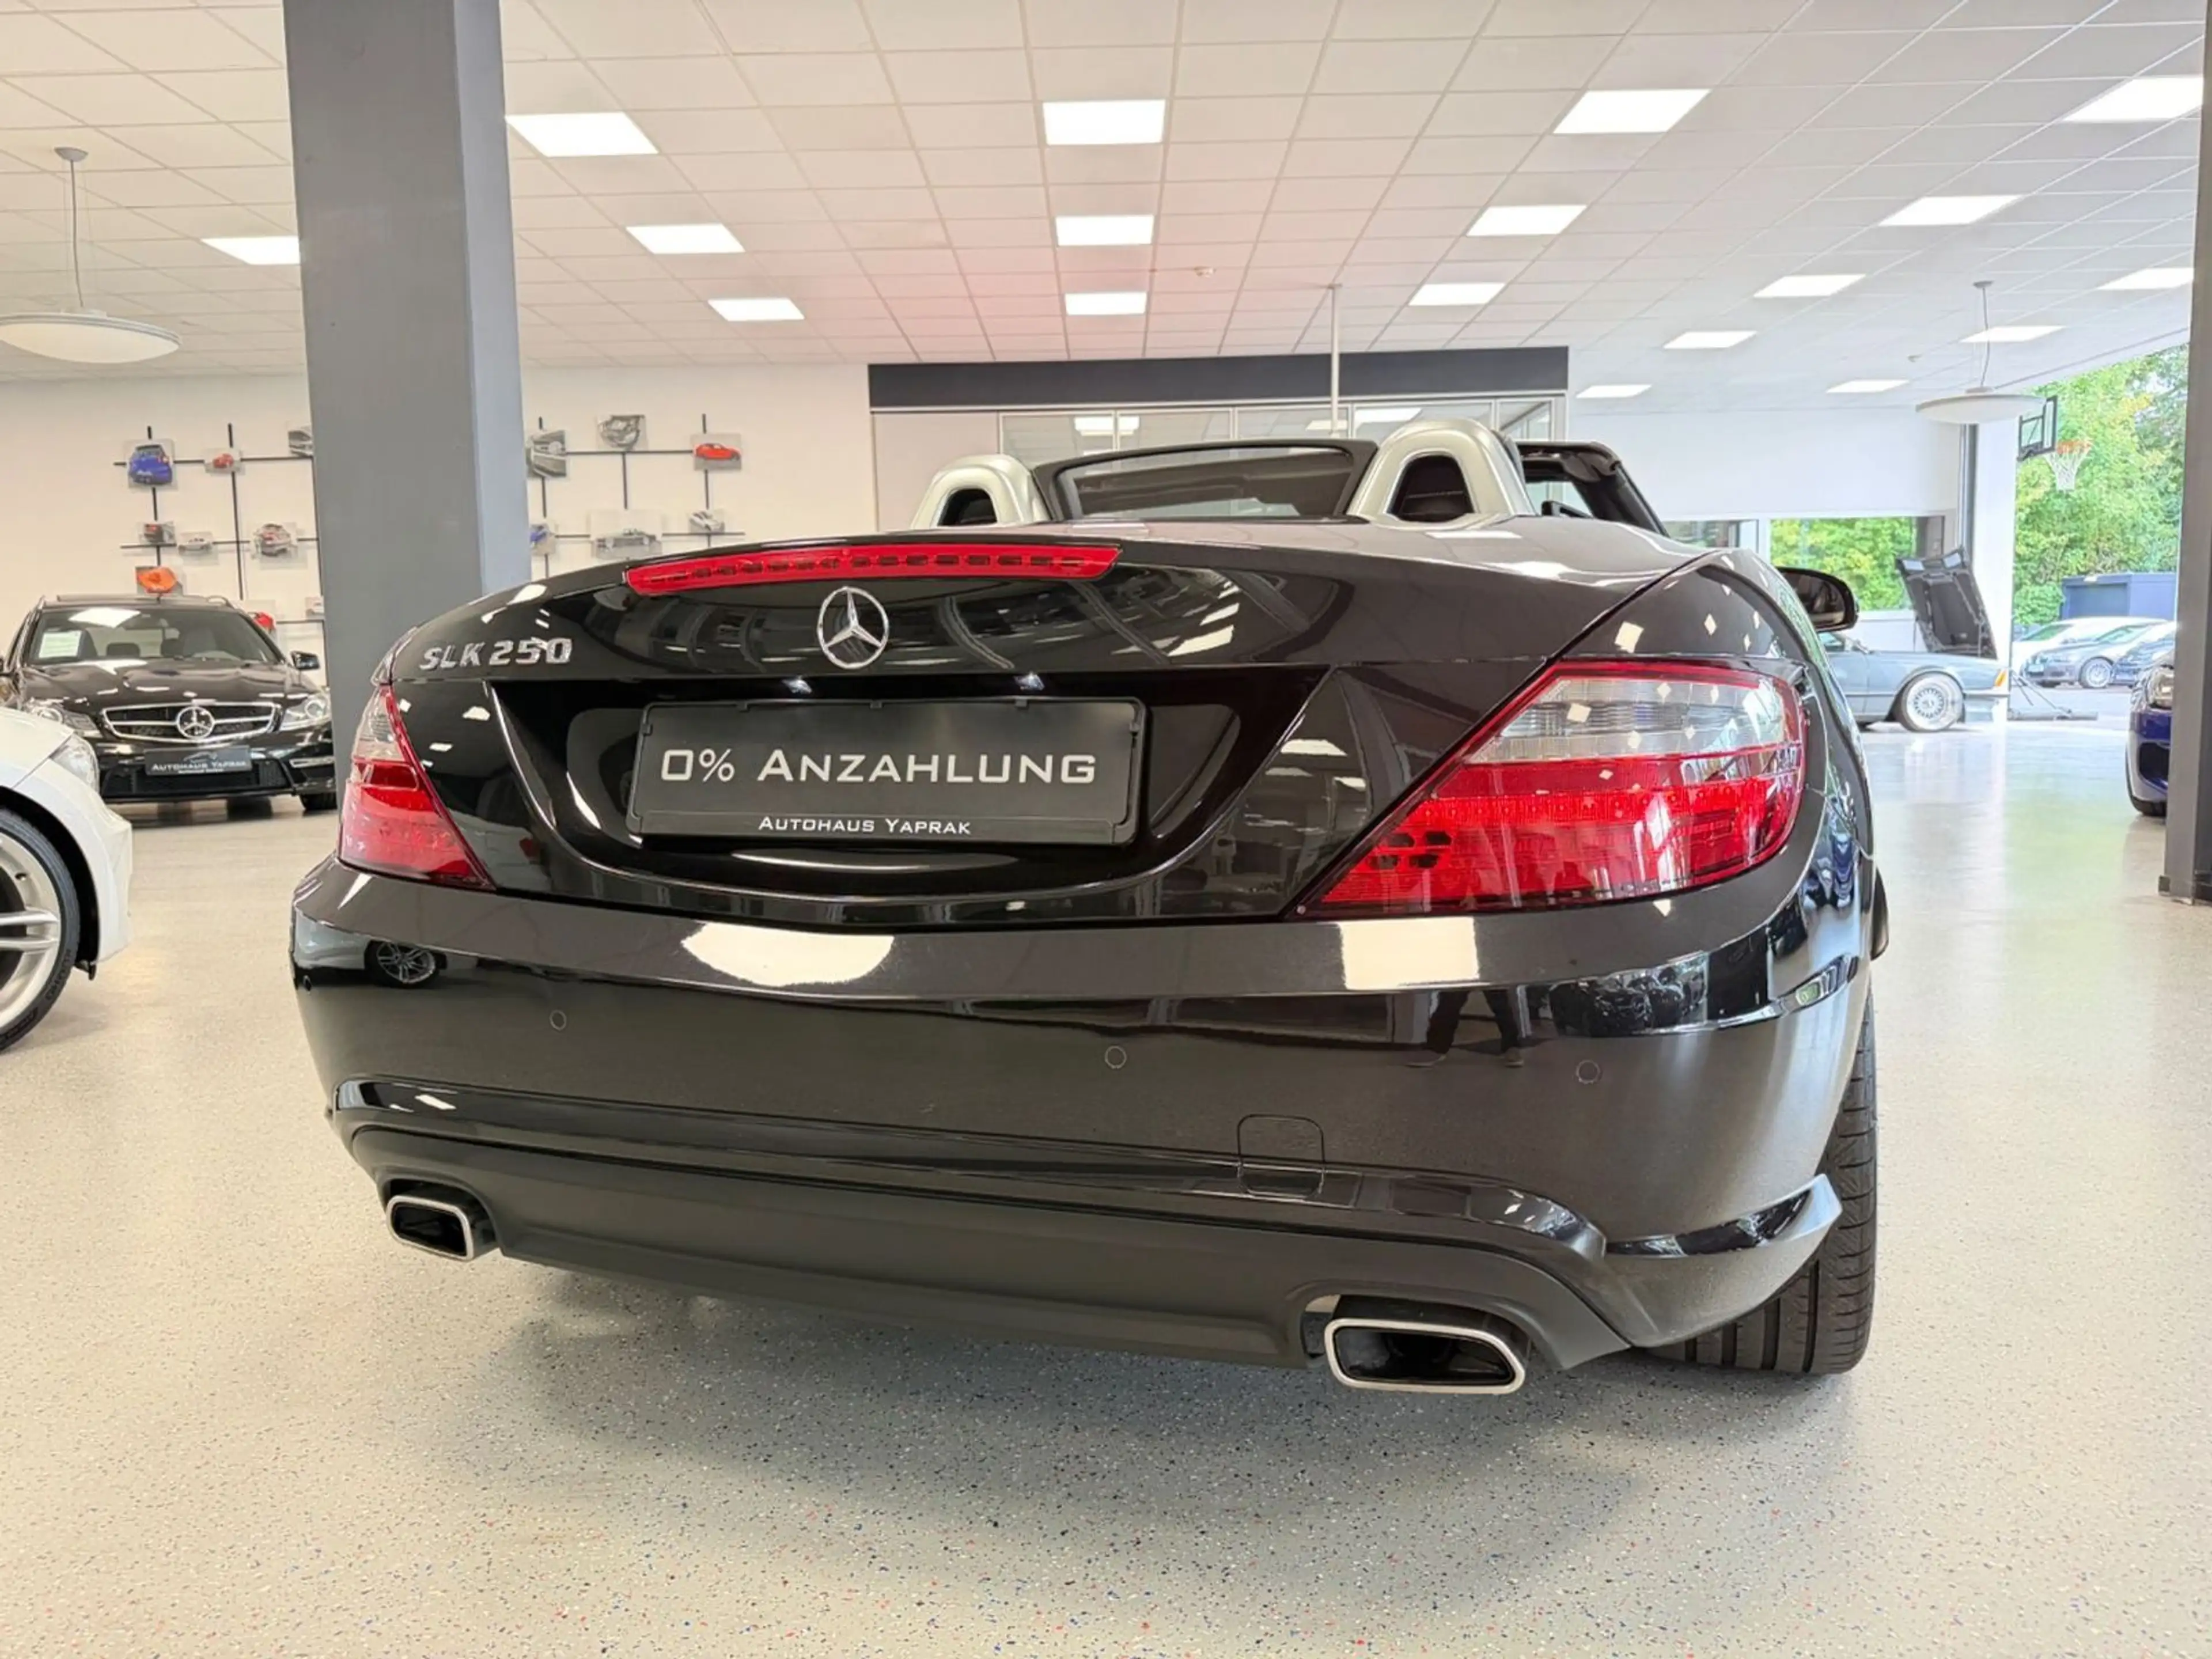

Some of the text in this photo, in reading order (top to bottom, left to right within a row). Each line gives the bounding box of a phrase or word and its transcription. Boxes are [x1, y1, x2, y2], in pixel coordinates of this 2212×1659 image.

[419, 637, 572, 669] SLK 250
[661, 748, 1096, 784] 0% ANZAHLUNG
[758, 816, 971, 835] AUTOHAUS YAPRAK
